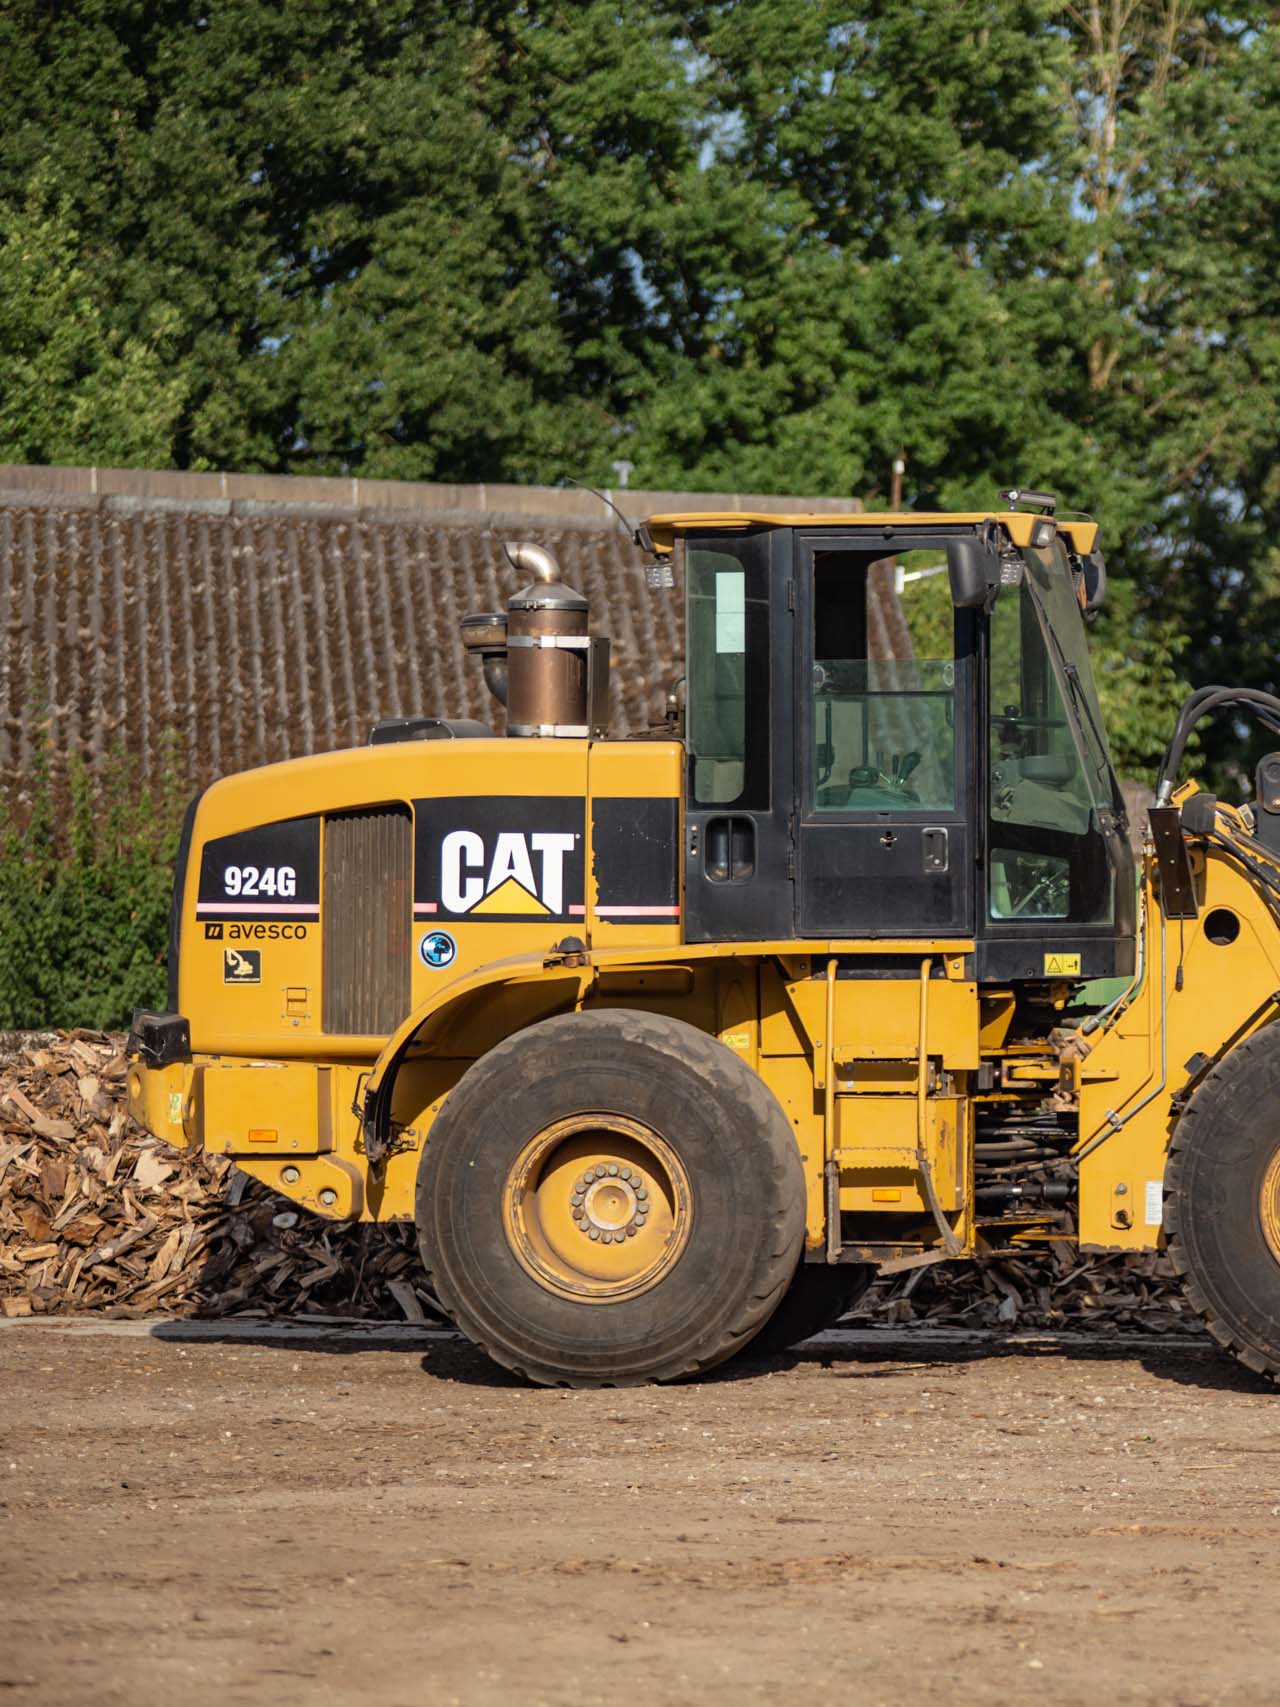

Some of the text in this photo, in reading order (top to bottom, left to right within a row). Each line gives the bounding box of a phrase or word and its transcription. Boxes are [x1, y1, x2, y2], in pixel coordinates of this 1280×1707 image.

[224, 866, 296, 897] 924G
[441, 830, 575, 914] CAT
[229, 924, 307, 940] avesco
